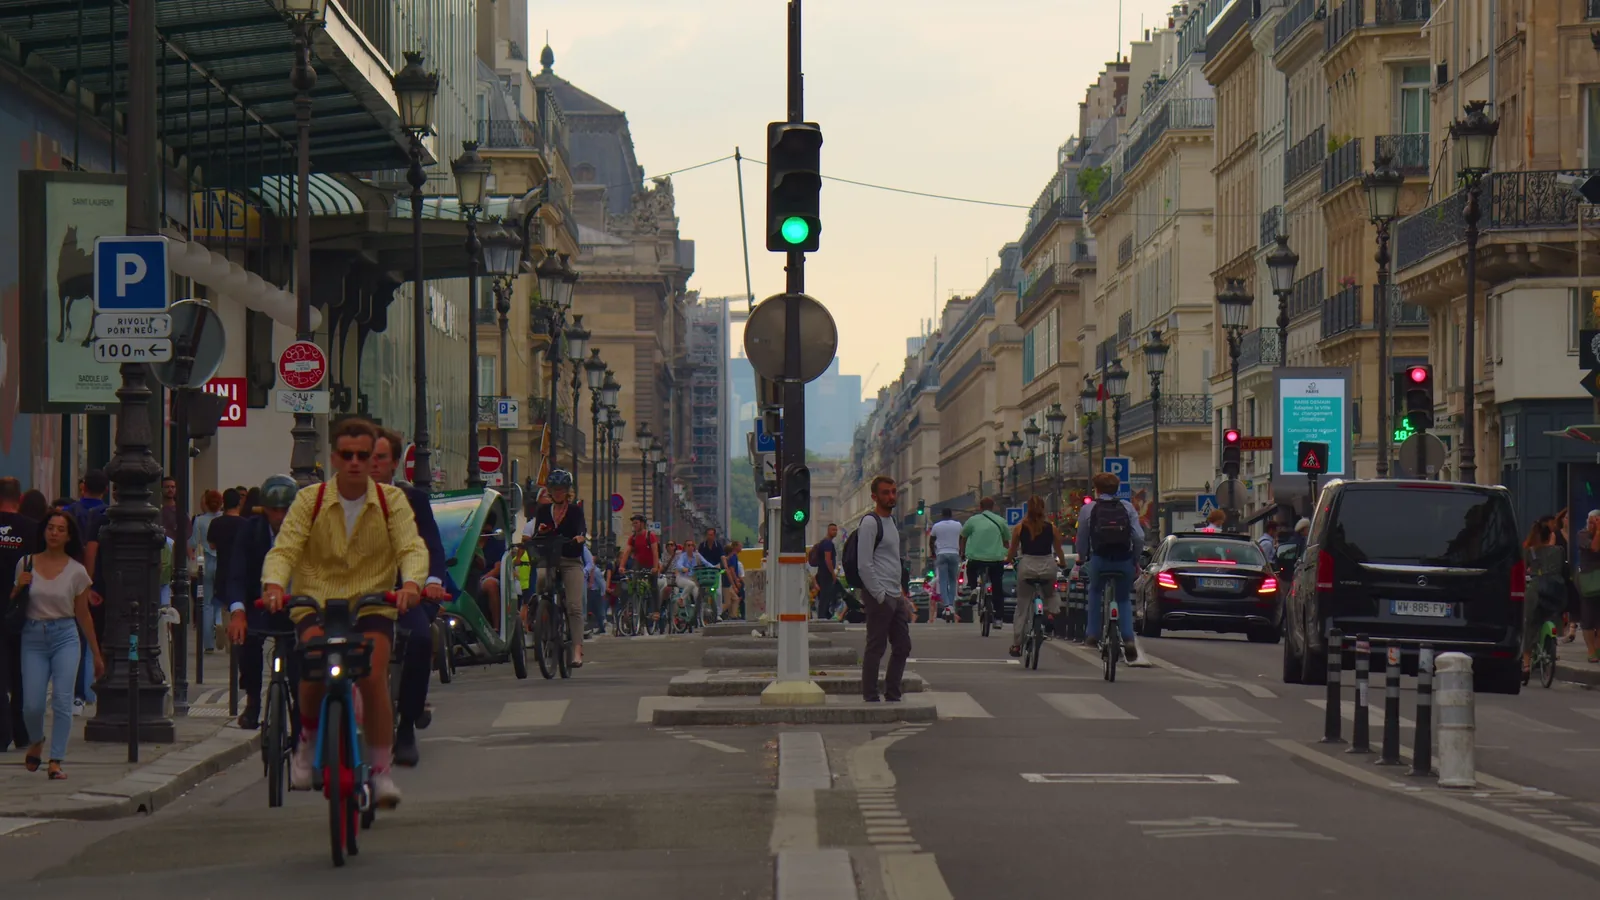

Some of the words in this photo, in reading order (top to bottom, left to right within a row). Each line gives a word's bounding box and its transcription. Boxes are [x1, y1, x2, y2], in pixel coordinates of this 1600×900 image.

[72, 198, 87, 206] SAINT
[116, 253, 148, 297] P
[107, 327, 132, 335] PONT
[292, 392, 315, 400] SAUF
[1011, 511, 1020, 522] P
